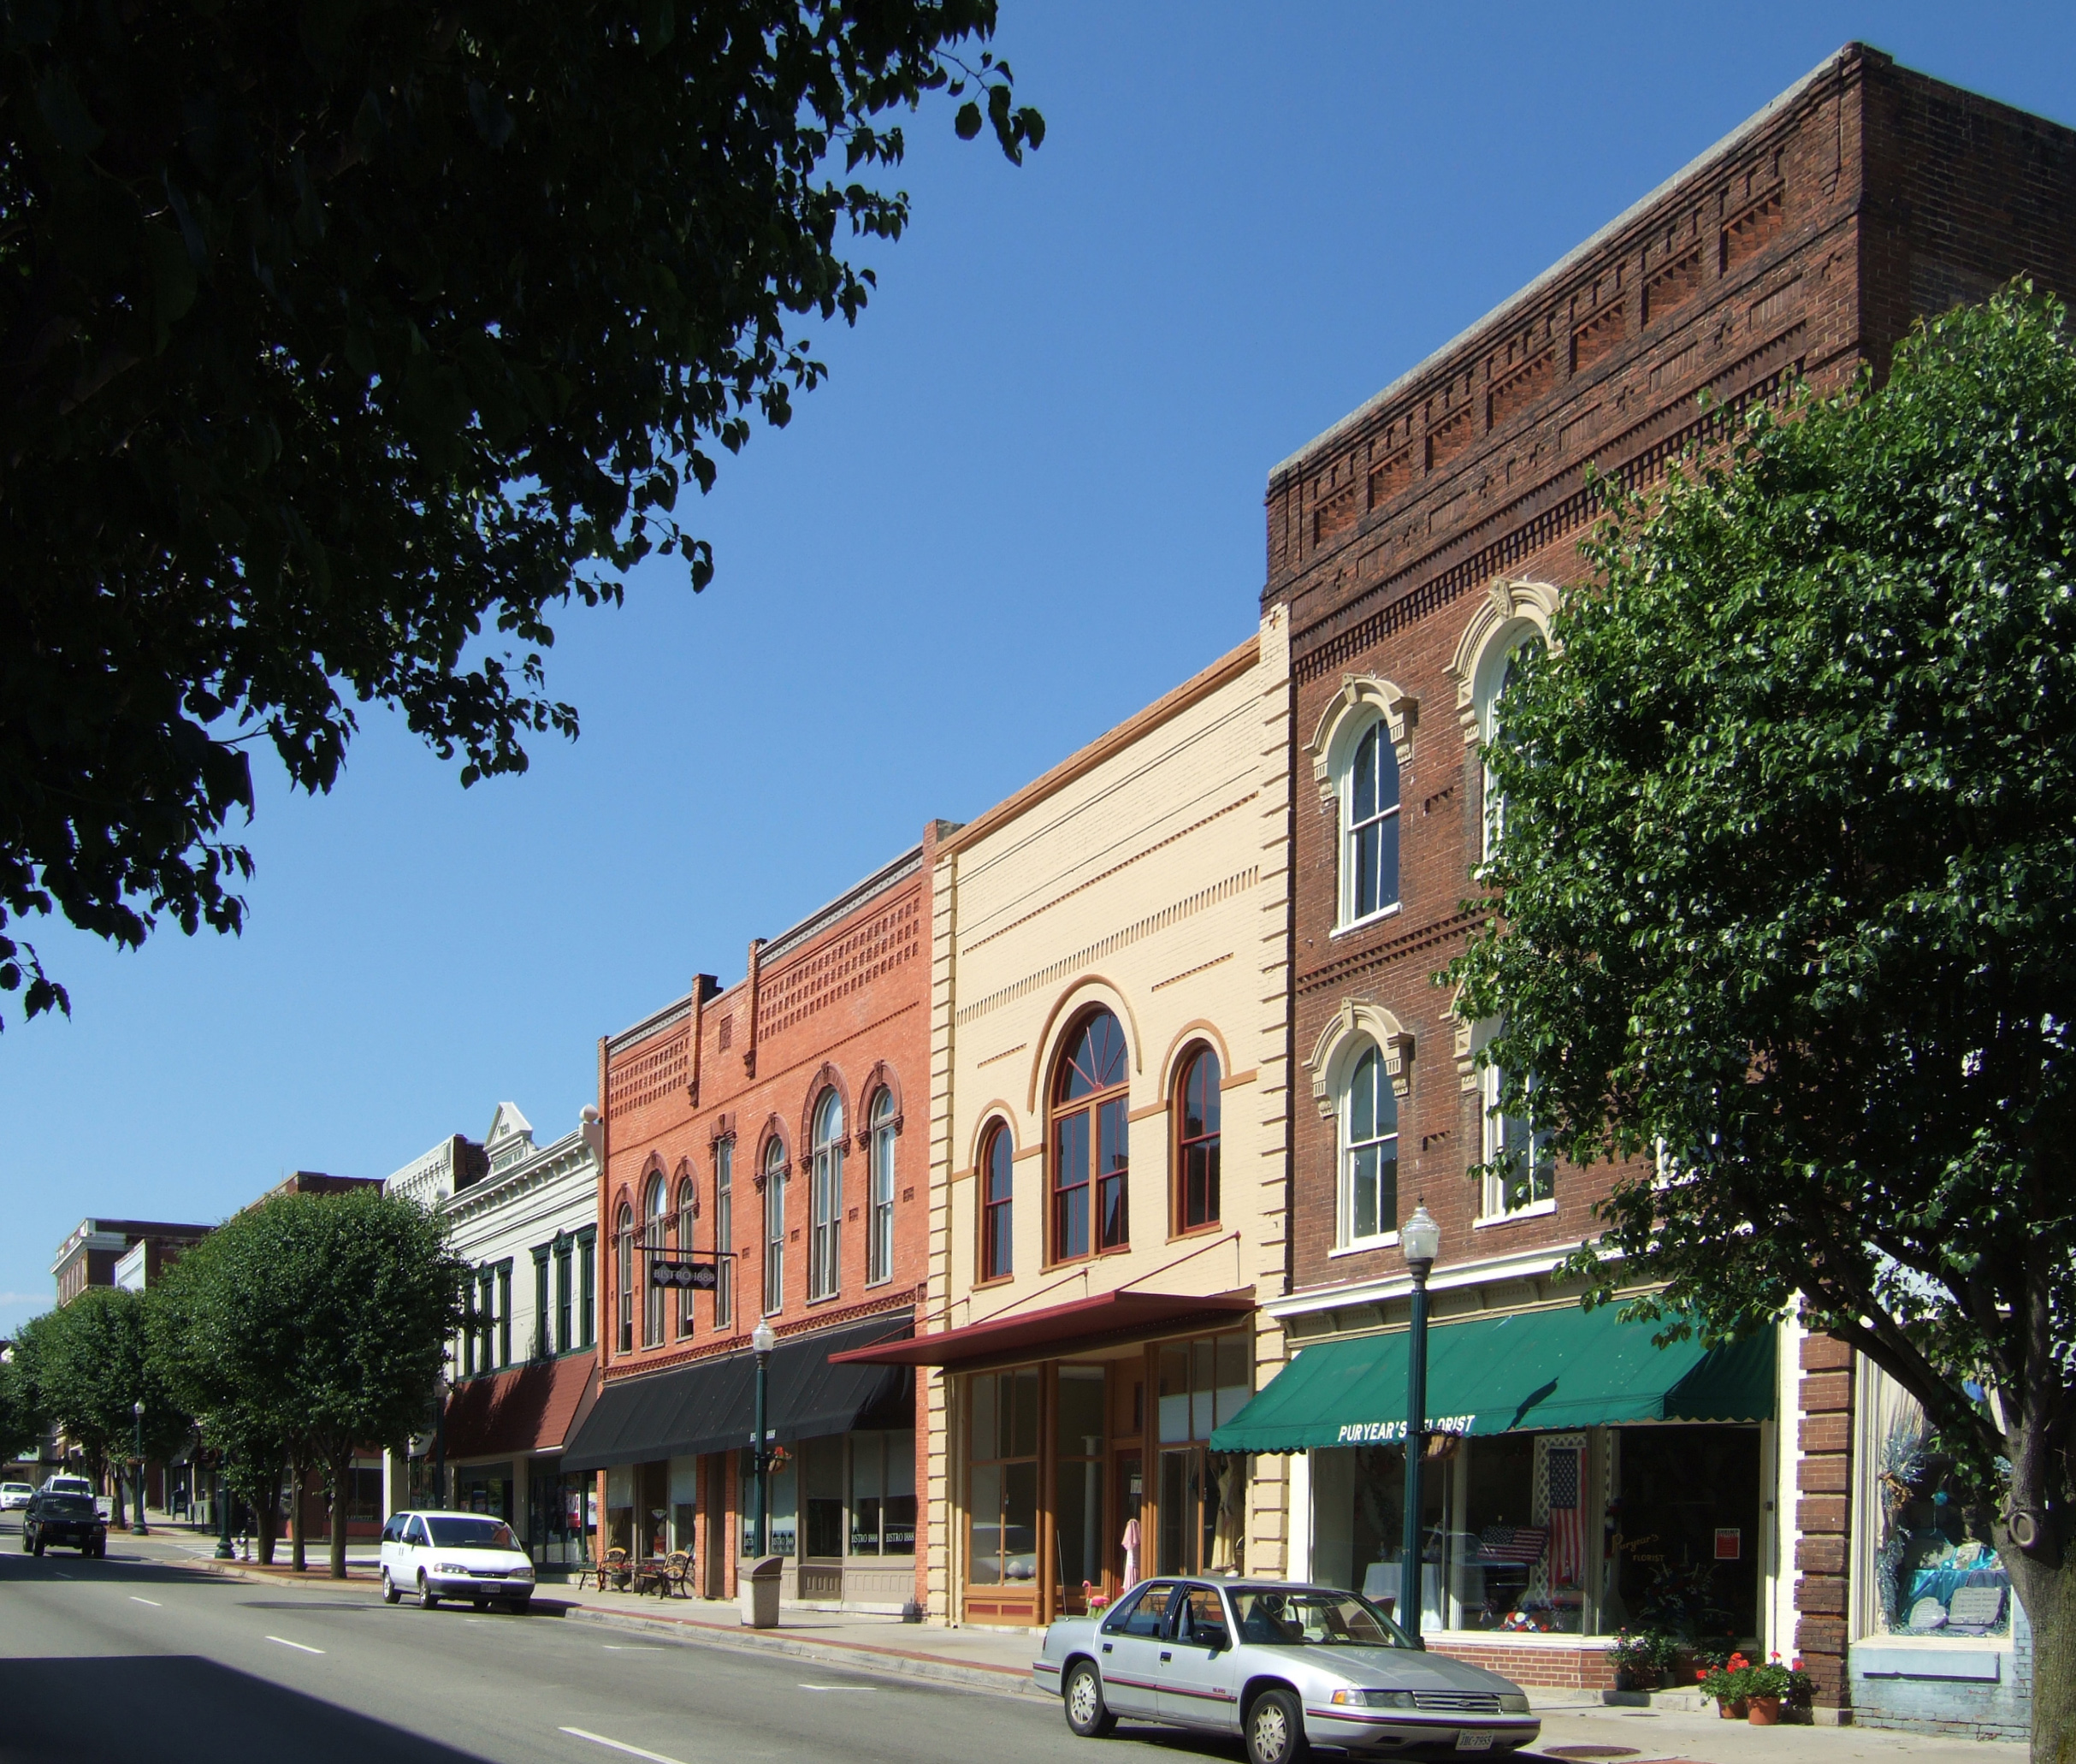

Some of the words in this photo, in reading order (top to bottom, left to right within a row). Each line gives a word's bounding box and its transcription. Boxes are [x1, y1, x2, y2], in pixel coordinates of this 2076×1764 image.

[654, 1269, 691, 1281] BISTRO
[694, 1272, 715, 1282] 1888
[1338, 1421, 1408, 1441] PURYEAR'S
[851, 1533, 867, 1543] BISTRO
[885, 1532, 903, 1542] BISTRO
[1612, 1533, 1659, 1554] Puryear's
